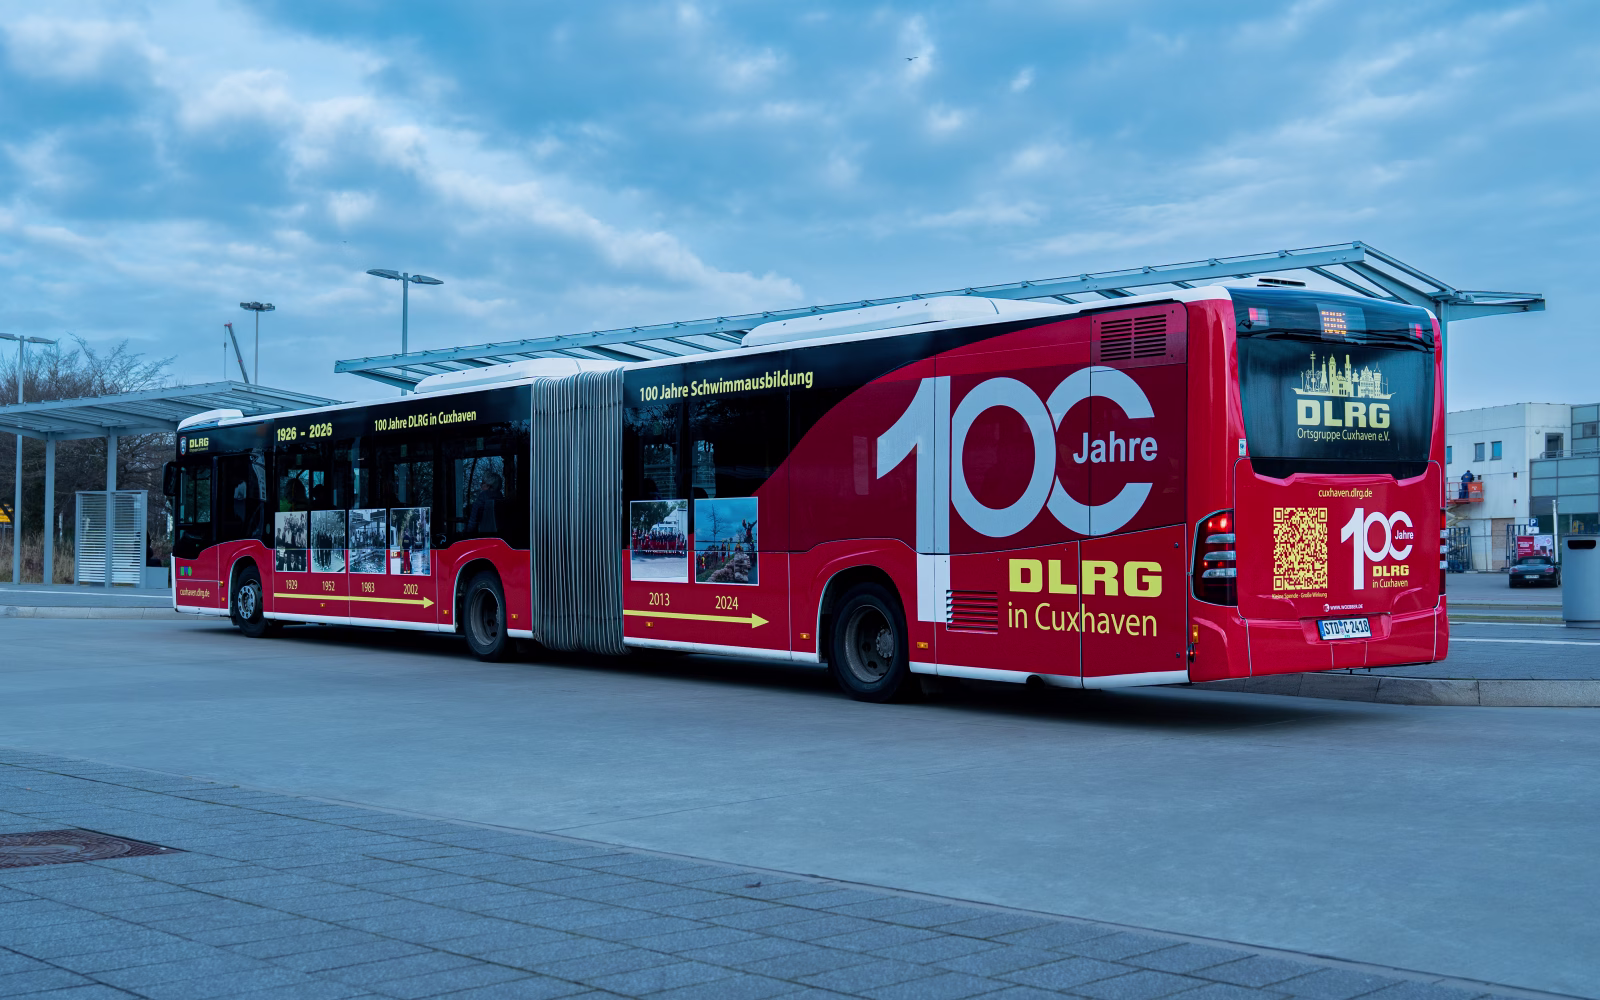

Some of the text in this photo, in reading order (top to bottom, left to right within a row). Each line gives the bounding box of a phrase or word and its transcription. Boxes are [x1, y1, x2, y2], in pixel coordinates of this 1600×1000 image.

[640, 370, 813, 402] 100 Jahre Schwimmausbildung
[375, 410, 476, 431] 100 Jahre DLRG in Cuxhaven
[1297, 399, 1390, 429] DLRG
[277, 427, 297, 441] 1926
[309, 422, 332, 438] 2026
[1297, 428, 1390, 442] Ortsgruppe Cuxhaven e.V.
[189, 438, 209, 448] DLRG
[1073, 431, 1157, 464] Jahre
[1318, 488, 1373, 500] cuxhaven.dlrg.de
[1395, 530, 1414, 540] Jahre
[1372, 565, 1409, 577] DLRG
[286, 580, 298, 590] 1929
[1009, 559, 1162, 598] DLRG
[1372, 578, 1408, 588] in Cuxhaven
[322, 581, 335, 591] 1952
[361, 582, 375, 593] 1983
[403, 584, 418, 595] 2002
[649, 592, 670, 606] 2013
[715, 596, 738, 610] 2024
[1008, 602, 1157, 637] in Cuxhaven
[1324, 620, 1369, 635] STD C 2418
